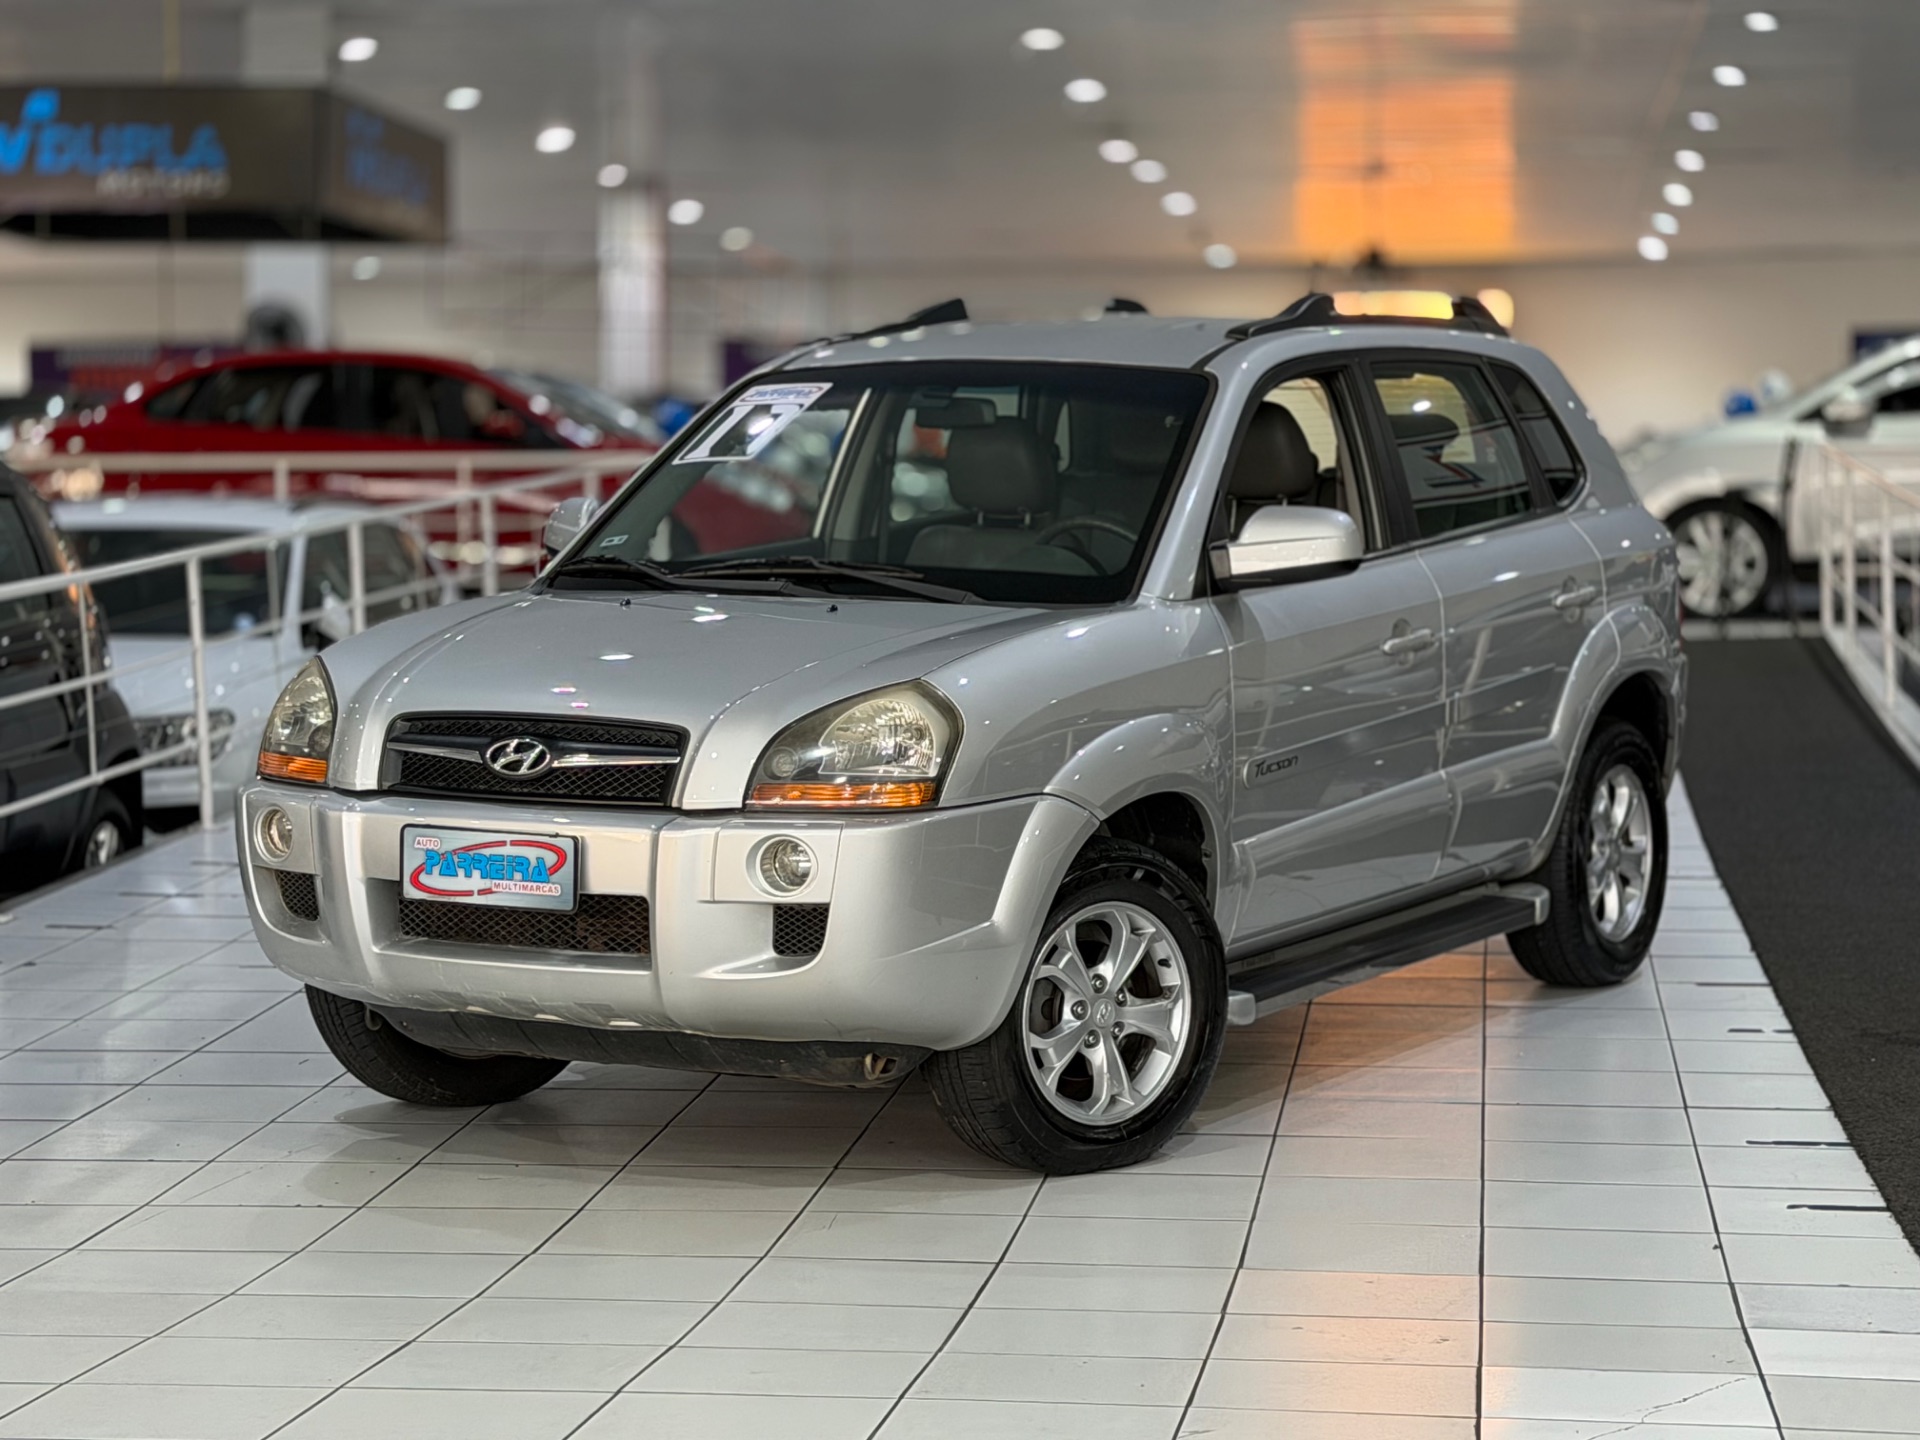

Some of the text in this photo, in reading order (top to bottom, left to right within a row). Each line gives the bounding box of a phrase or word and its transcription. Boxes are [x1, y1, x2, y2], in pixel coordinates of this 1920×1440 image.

[1255, 755, 1299, 778] Tucson
[415, 838, 440, 848] AUTO
[424, 848, 550, 883] PARREIRA
[493, 882, 560, 894] MULTIMARCAS
